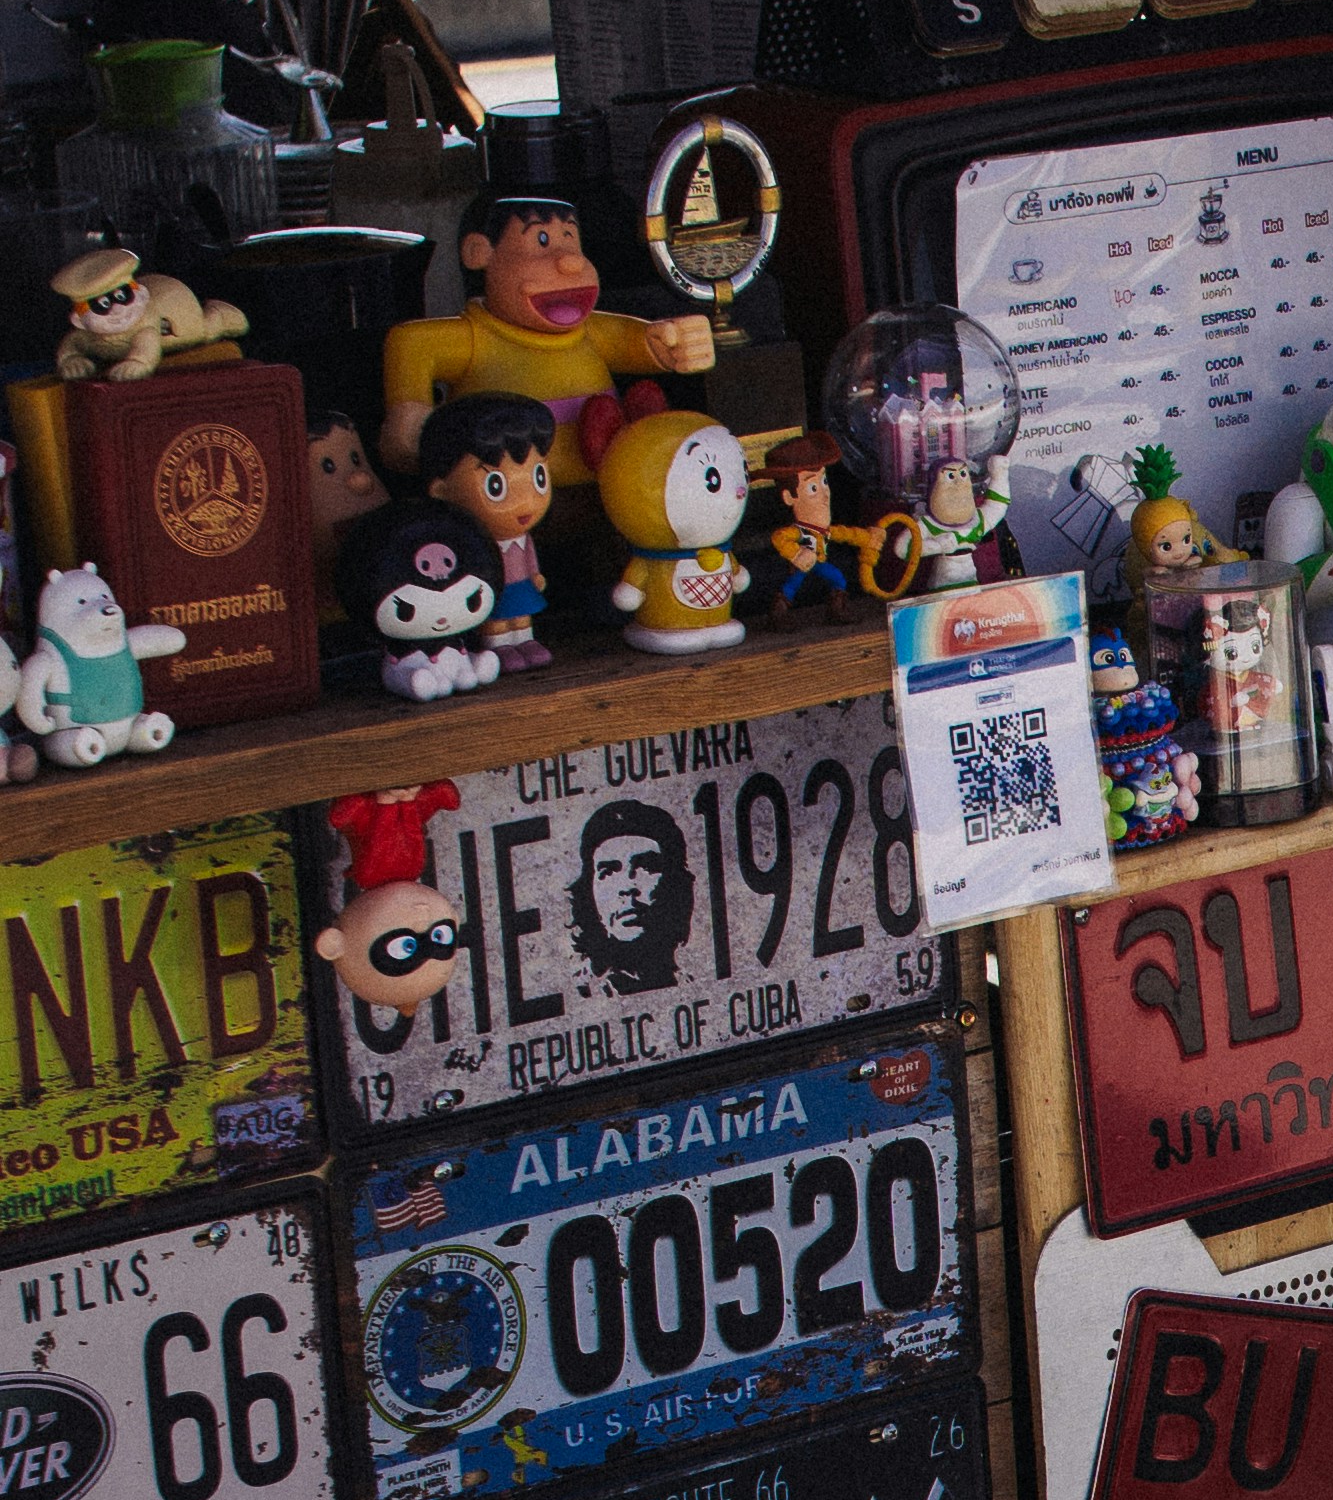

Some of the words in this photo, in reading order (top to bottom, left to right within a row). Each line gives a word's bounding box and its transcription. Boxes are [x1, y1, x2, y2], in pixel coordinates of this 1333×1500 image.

[1237, 146, 1279, 167] MENU
[1262, 218, 1284, 234] Hot
[1305, 210, 1329, 227] Iced
[1108, 241, 1132, 258] Hot
[1148, 235, 1173, 252] Iced
[1200, 268, 1240, 284] MOCCA
[1008, 297, 1078, 317] AMERICANO
[1201, 307, 1256, 326] ESPRESSO
[1009, 342, 1045, 357] HONEY
[1048, 332, 1108, 352] AMERICANO
[1205, 356, 1244, 372] COCOA
[1015, 387, 1049, 401] ATTE
[1208, 391, 1253, 408] OVALTIN
[1015, 420, 1092, 441] CAPPUCCINO
[978, 611, 1026, 628] Krungthai
[516, 752, 584, 805] CHE
[604, 720, 754, 788] GUEVARA
[692, 746, 922, 981] 1928
[509, 1011, 655, 1092] REPUBLIC
[674, 998, 710, 1050] OF
[729, 979, 803, 1037] CUBA
[884, 1082, 919, 1098] DIXIE
[894, 1074, 907, 1084] OF
[359, 1071, 396, 1124] 19
[66, 1108, 180, 1161] USA
[510, 1081, 809, 1194] ALABAMA
[547, 1136, 942, 1398] 00520
[20, 1252, 151, 1324] WILKS
[365, 1275, 405, 1390] DEPARTMEN
[446, 1254, 478, 1272] THE
[481, 1266, 506, 1292] AIR
[501, 1295, 518, 1353] FORCE
[644, 1393, 693, 1428] AIR
[1133, 1330, 1321, 1494] BU
[930, 1414, 967, 1458] 26
